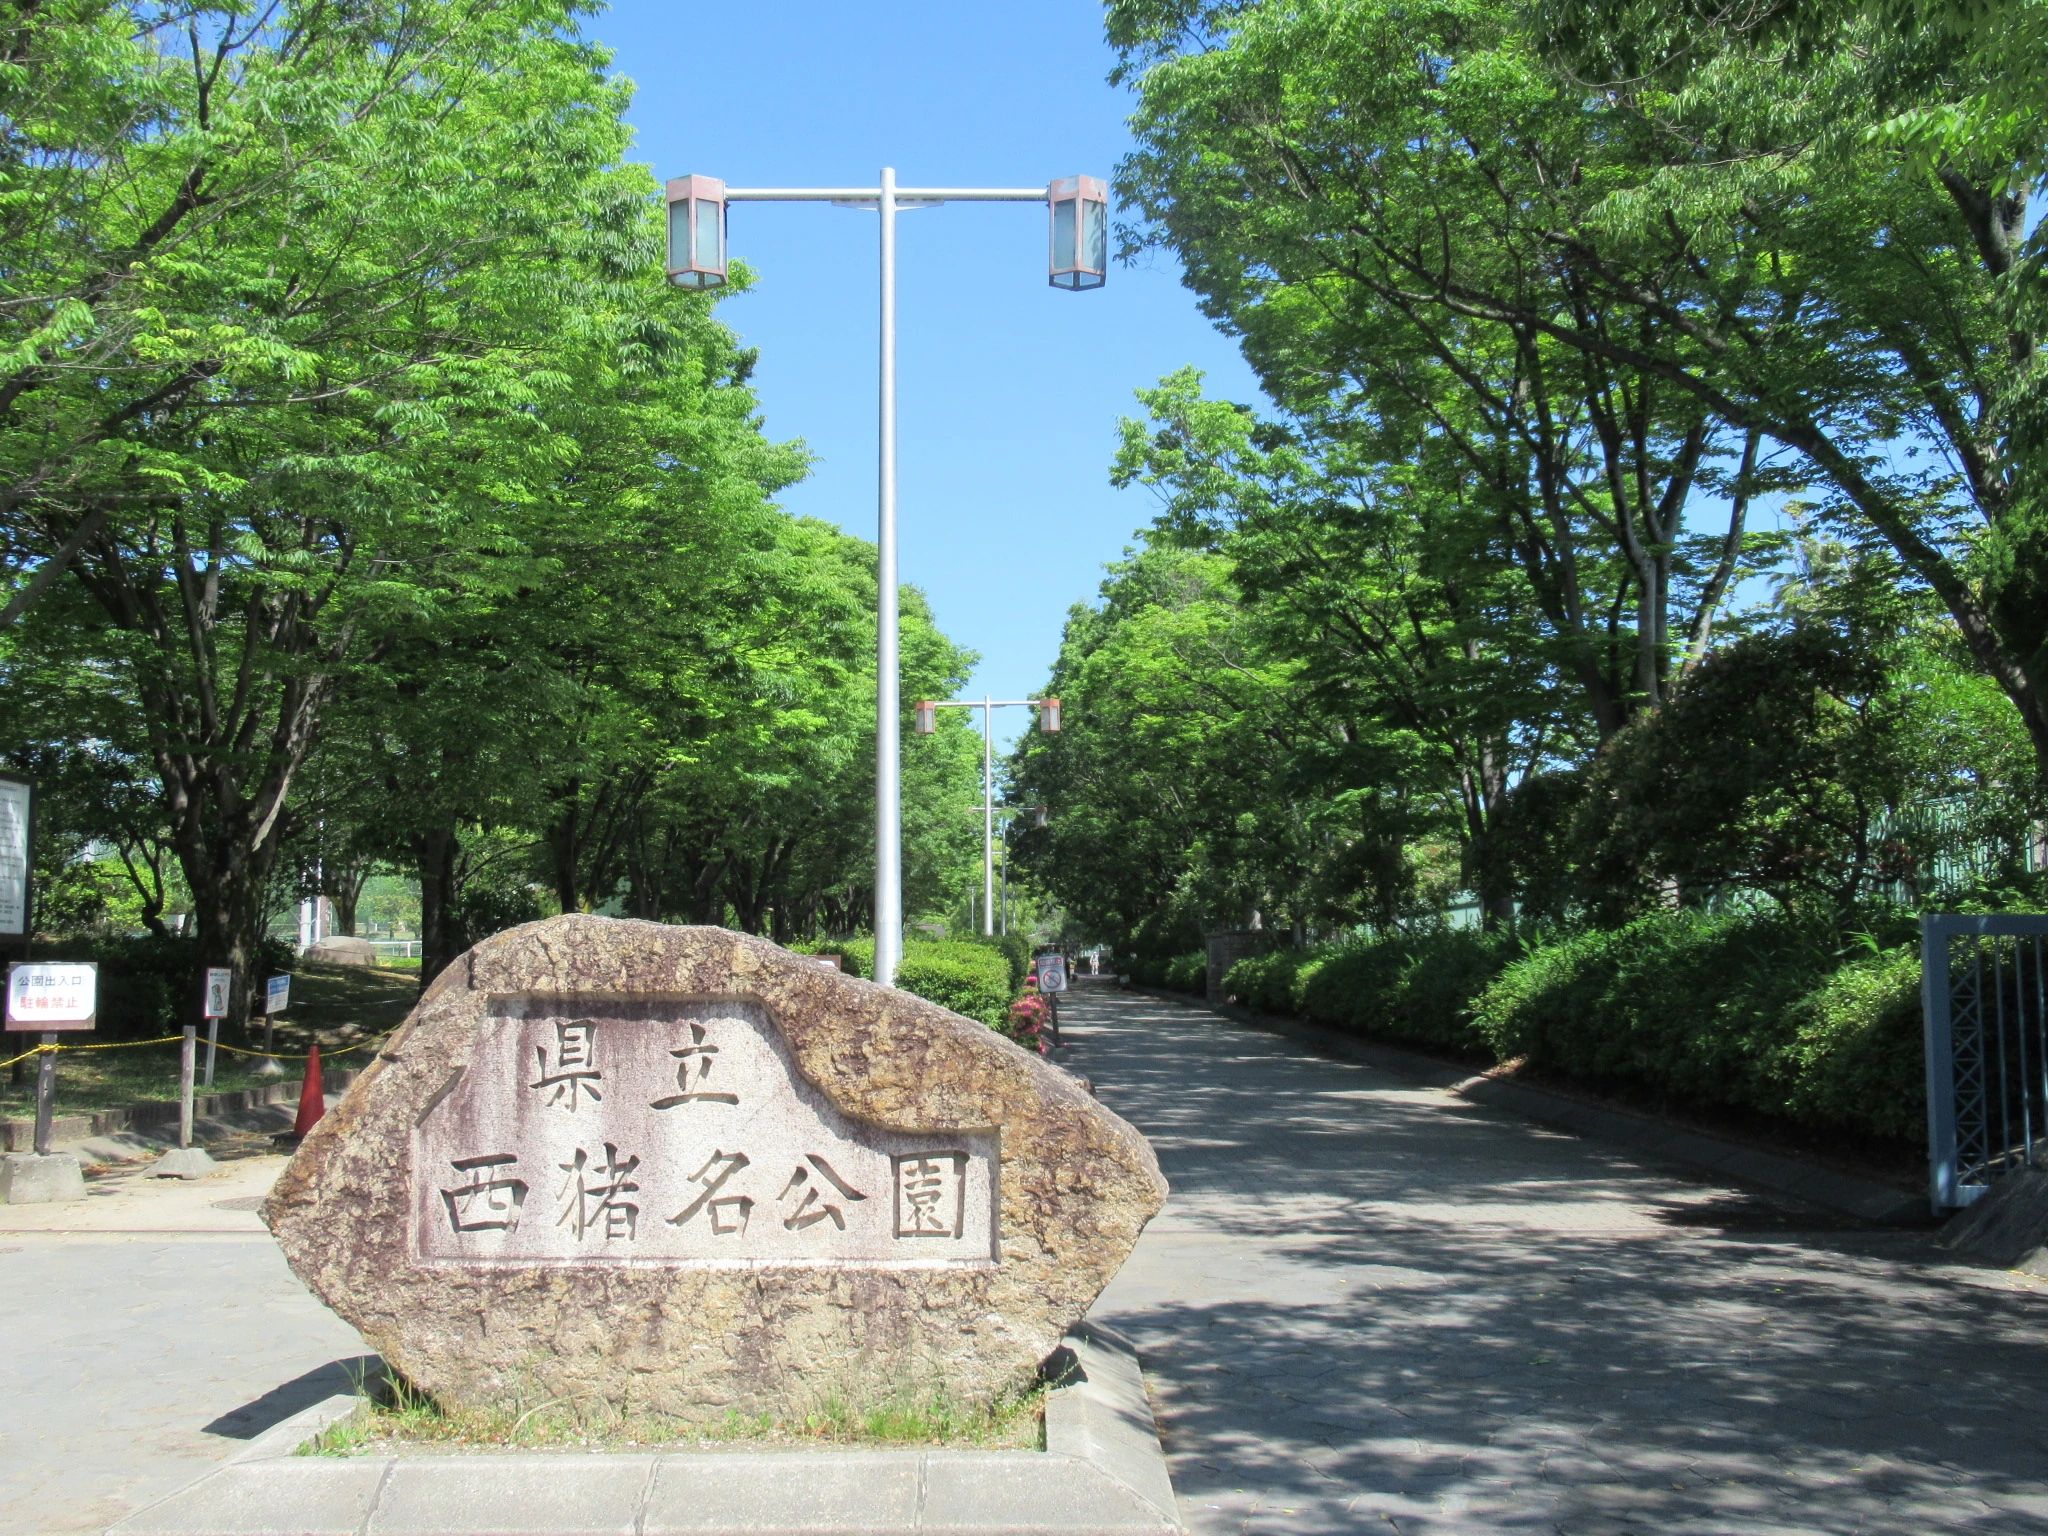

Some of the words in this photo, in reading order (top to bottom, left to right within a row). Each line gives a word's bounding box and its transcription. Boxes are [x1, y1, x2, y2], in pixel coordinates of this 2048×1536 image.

[18, 976, 82, 987] 公園出入口
[20, 996, 78, 1009] 駐輪禁止
[529, 1019, 740, 1113] 県立
[439, 1141, 971, 1242] 西猪名公園
